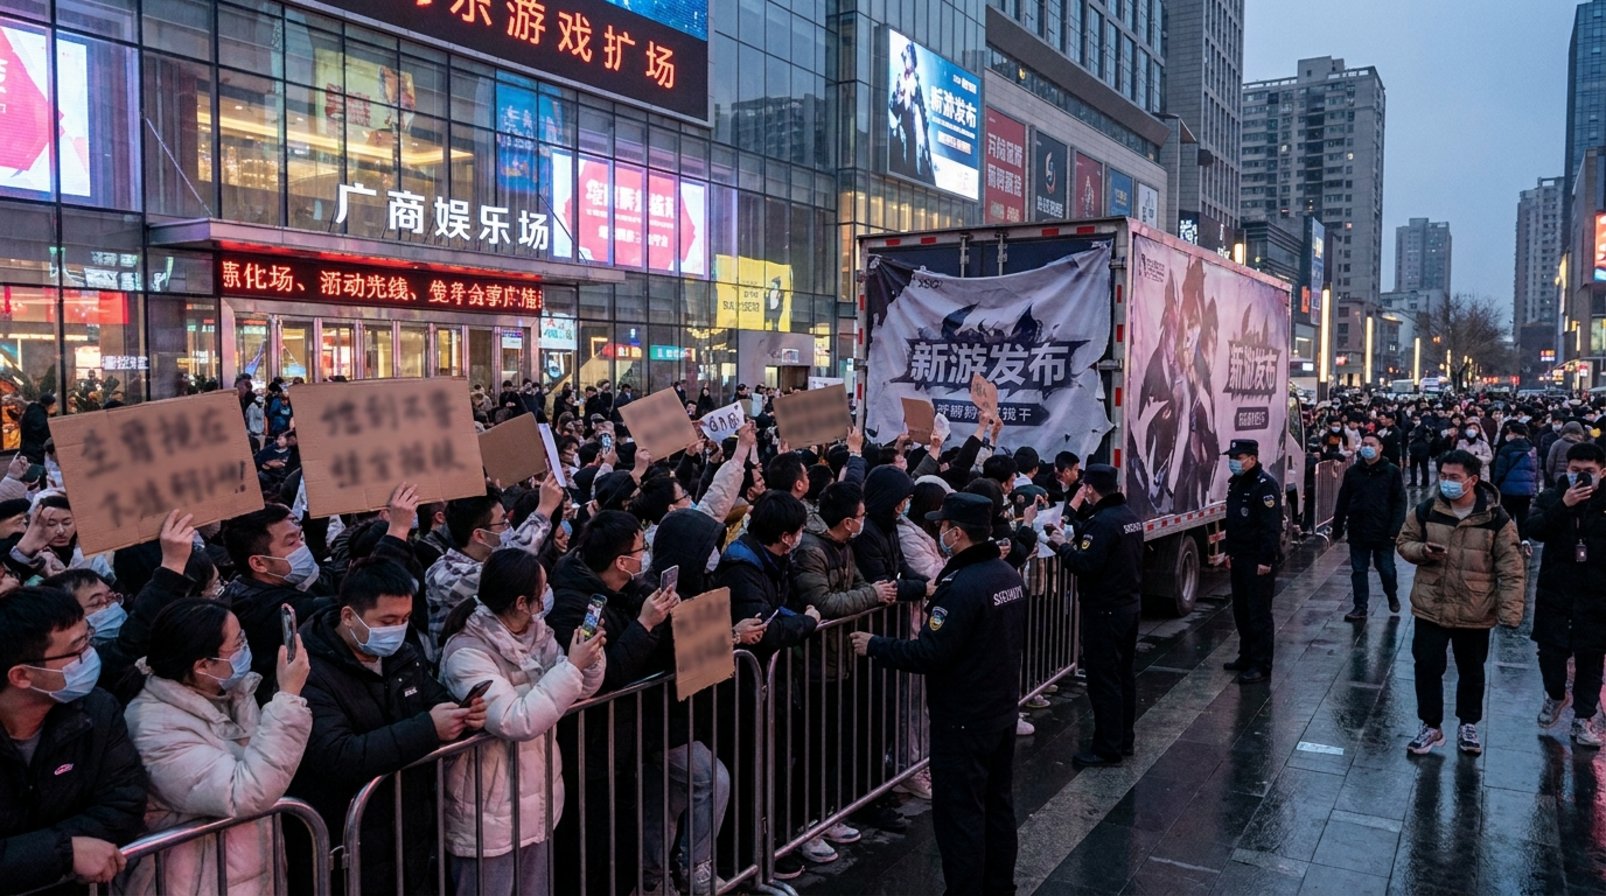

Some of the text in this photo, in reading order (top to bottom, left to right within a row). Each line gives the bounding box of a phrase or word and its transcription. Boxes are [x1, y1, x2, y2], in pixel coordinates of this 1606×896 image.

[335, 182, 549, 250] 广商娱乐场
[910, 342, 1069, 387] 新游发布
[1229, 345, 1277, 391] 新游发布
